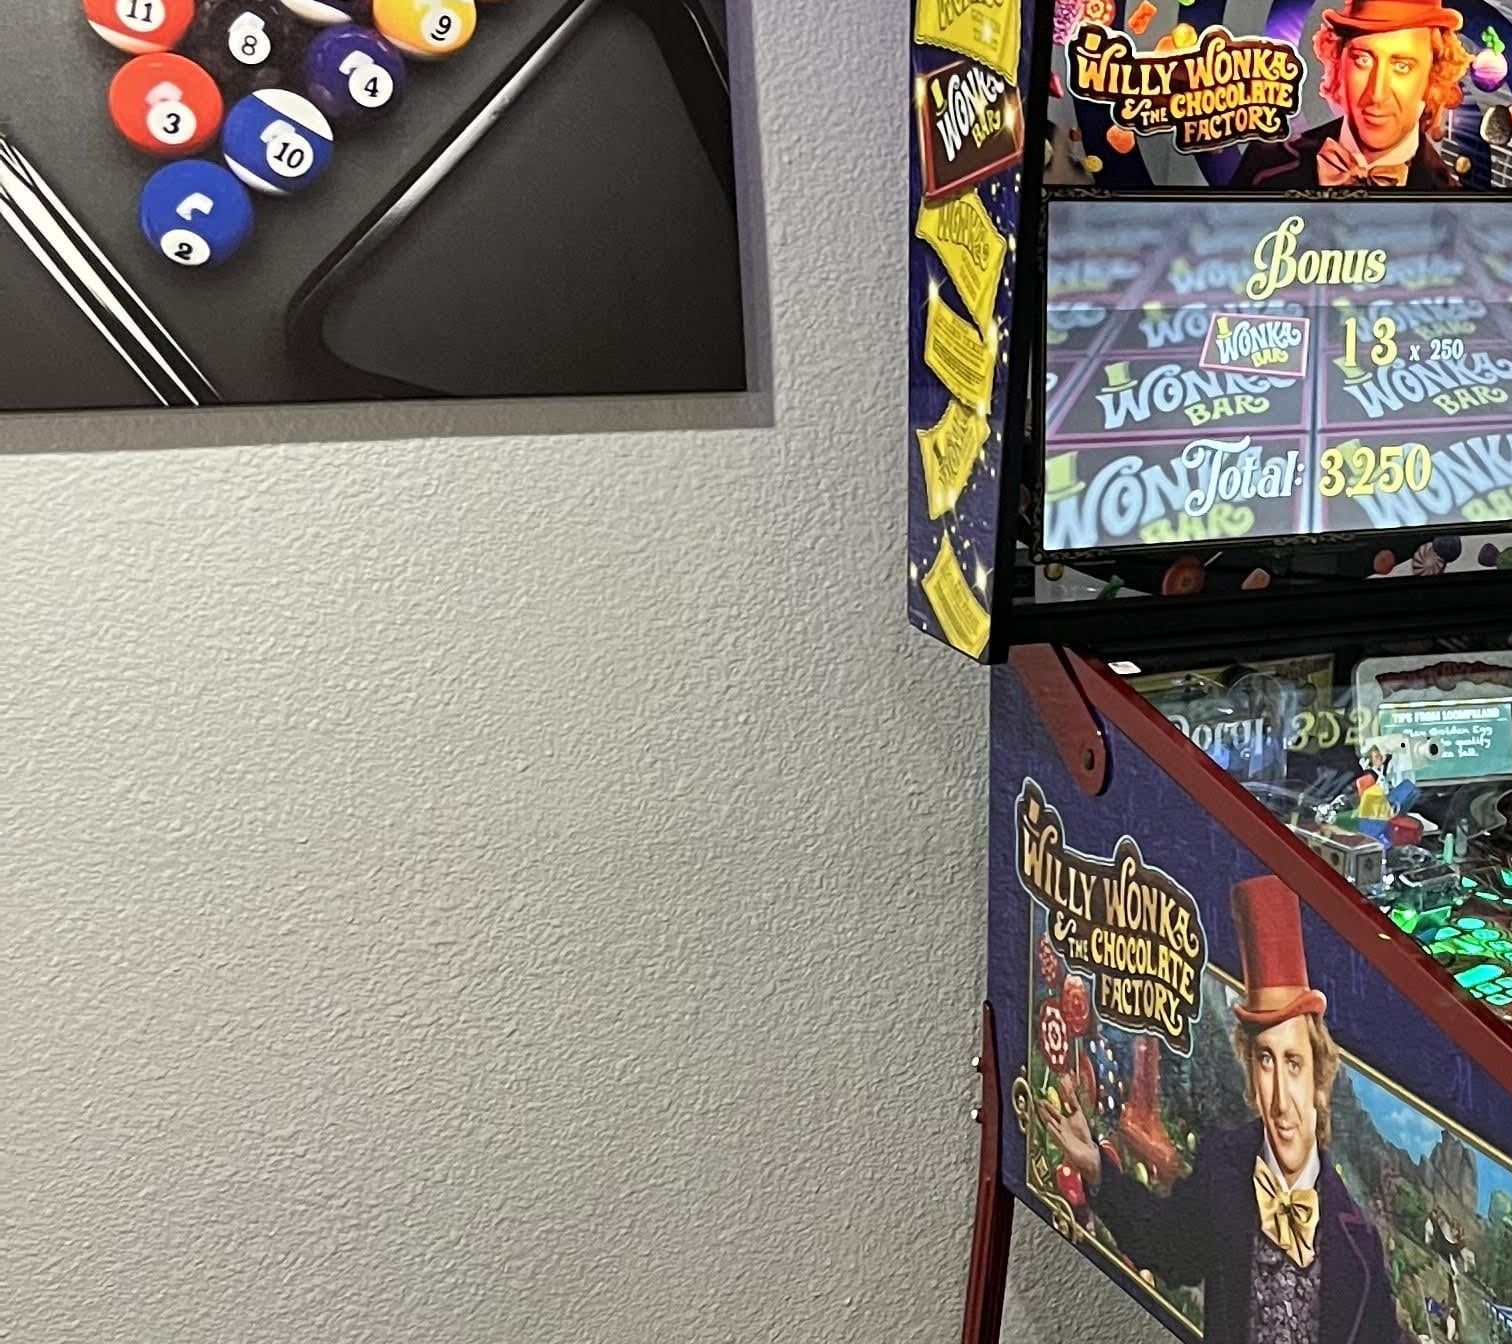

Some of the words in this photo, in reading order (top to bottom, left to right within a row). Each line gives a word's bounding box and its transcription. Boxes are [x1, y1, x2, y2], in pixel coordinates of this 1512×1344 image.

[126, 0, 153, 23] 11
[433, 15, 452, 36] 9
[241, 35, 257, 56] 8
[1077, 43, 1179, 96] WILLY
[1184, 36, 1299, 90] WONKA
[364, 77, 379, 97] 4
[1121, 98, 1152, 120] &
[1140, 107, 1169, 127] THE
[1169, 79, 1294, 119] CHOCOLATE
[162, 113, 182, 134] 3
[937, 67, 1005, 162] WONKA
[972, 109, 1001, 149] BAR
[1184, 106, 1281, 144] FACTORY
[273, 142, 305, 169] 10
[174, 242, 195, 260] 2
[1245, 215, 1388, 301] Bonus
[1215, 320, 1302, 364] WONKA
[1250, 348, 1289, 368] BAR
[1408, 344, 1421, 360] x
[1430, 338, 1464, 360] 250
[1095, 364, 1297, 429] WONK
[1184, 394, 1270, 427] BAR
[1432, 385, 1509, 416] BAR
[1181, 435, 1305, 517] Total:
[1391, 712, 1413, 724] TIPS
[1414, 710, 1441, 723] FROM
[1428, 725, 1470, 736] Golden
[1472, 725, 1493, 737] Egg
[1455, 733, 1492, 749] qualify
[1023, 825, 1097, 921] WILLY
[1103, 856, 1200, 958] WONKA
[1053, 910, 1077, 941] &
[1068, 937, 1089, 962] THE
[1091, 927, 1196, 1006] CHOCOLATE
[1101, 972, 1183, 1037] FACTORY
